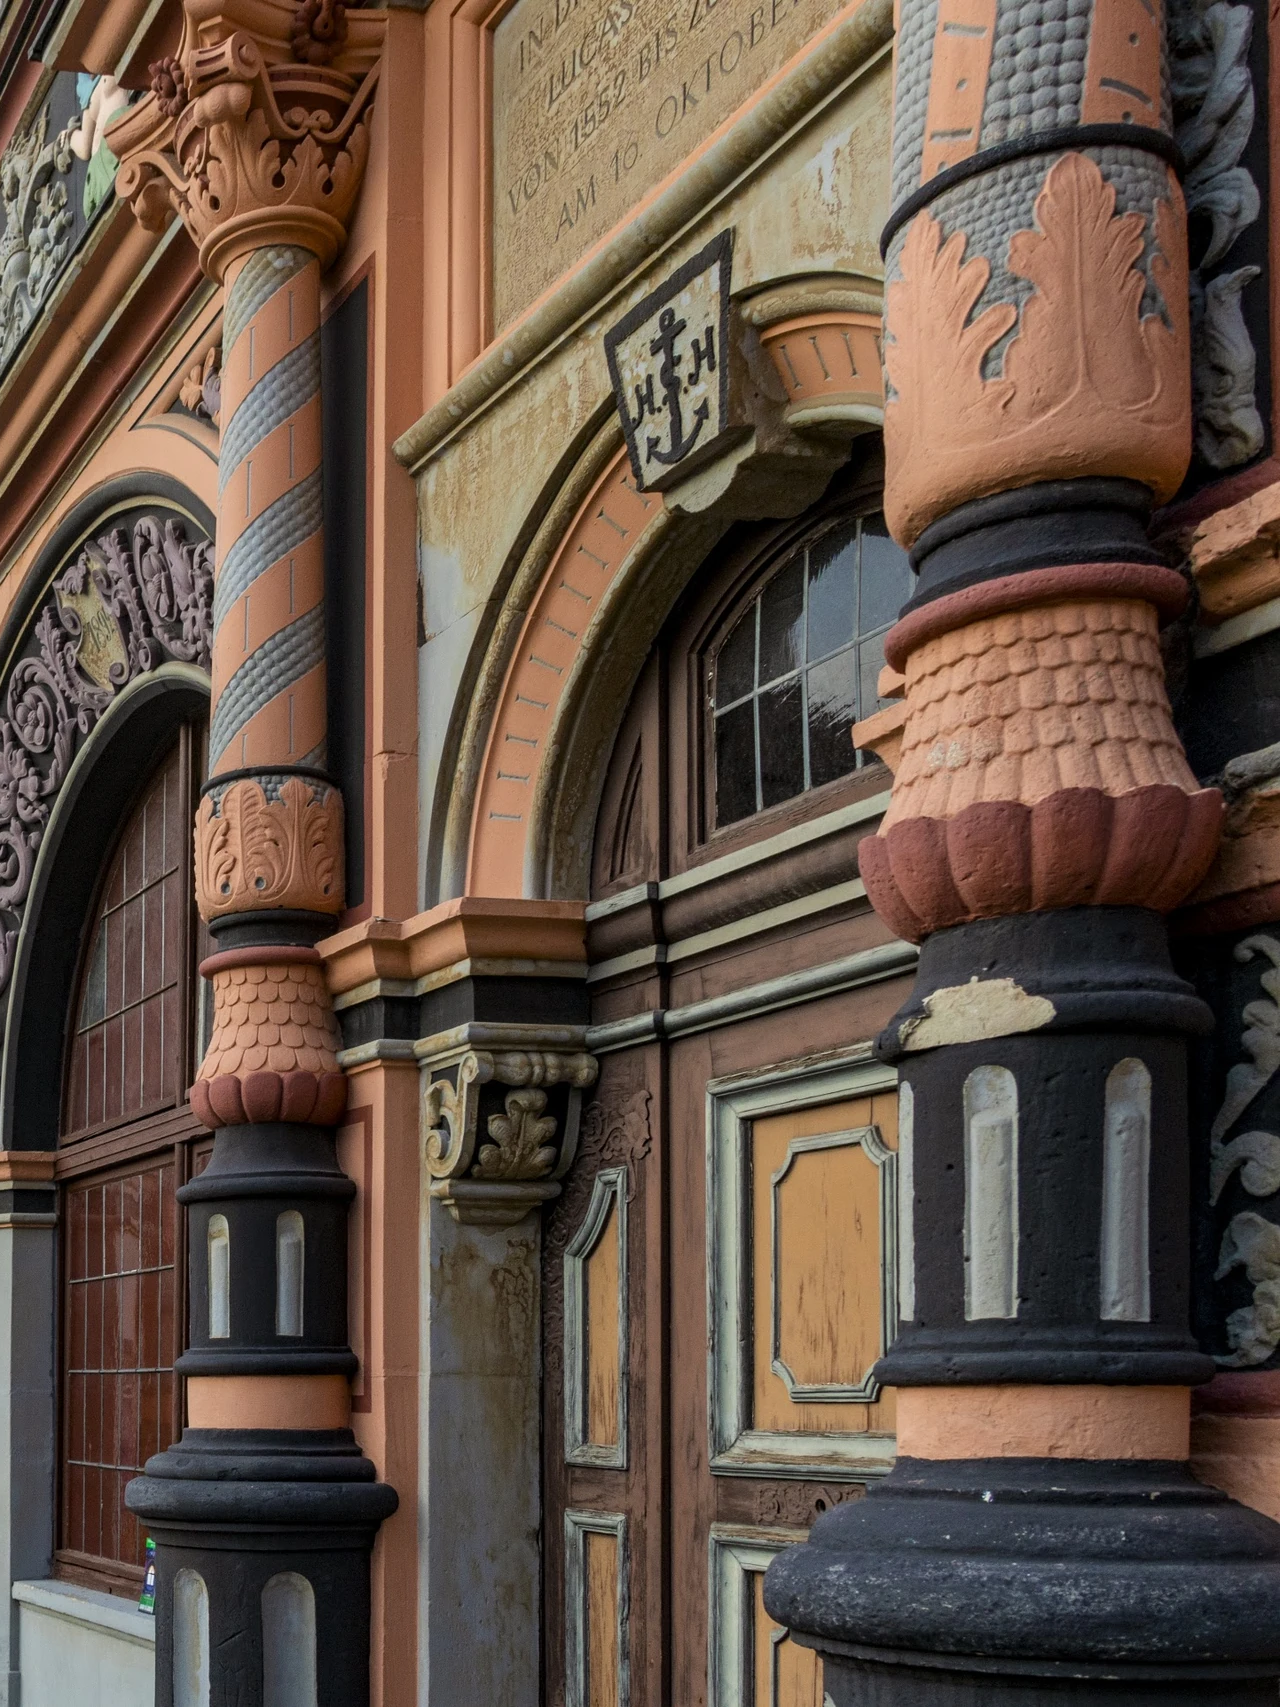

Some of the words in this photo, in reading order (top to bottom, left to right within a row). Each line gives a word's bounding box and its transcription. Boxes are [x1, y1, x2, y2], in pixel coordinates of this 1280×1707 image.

[507, 137, 561, 216] VON
[570, 69, 627, 151] 1552
[638, 13, 678, 84] BIS
[519, 16, 544, 74] IN
[546, 1, 634, 112] LUCAS
[554, 174, 597, 244] AM
[654, 0, 798, 139] OKTOBE
